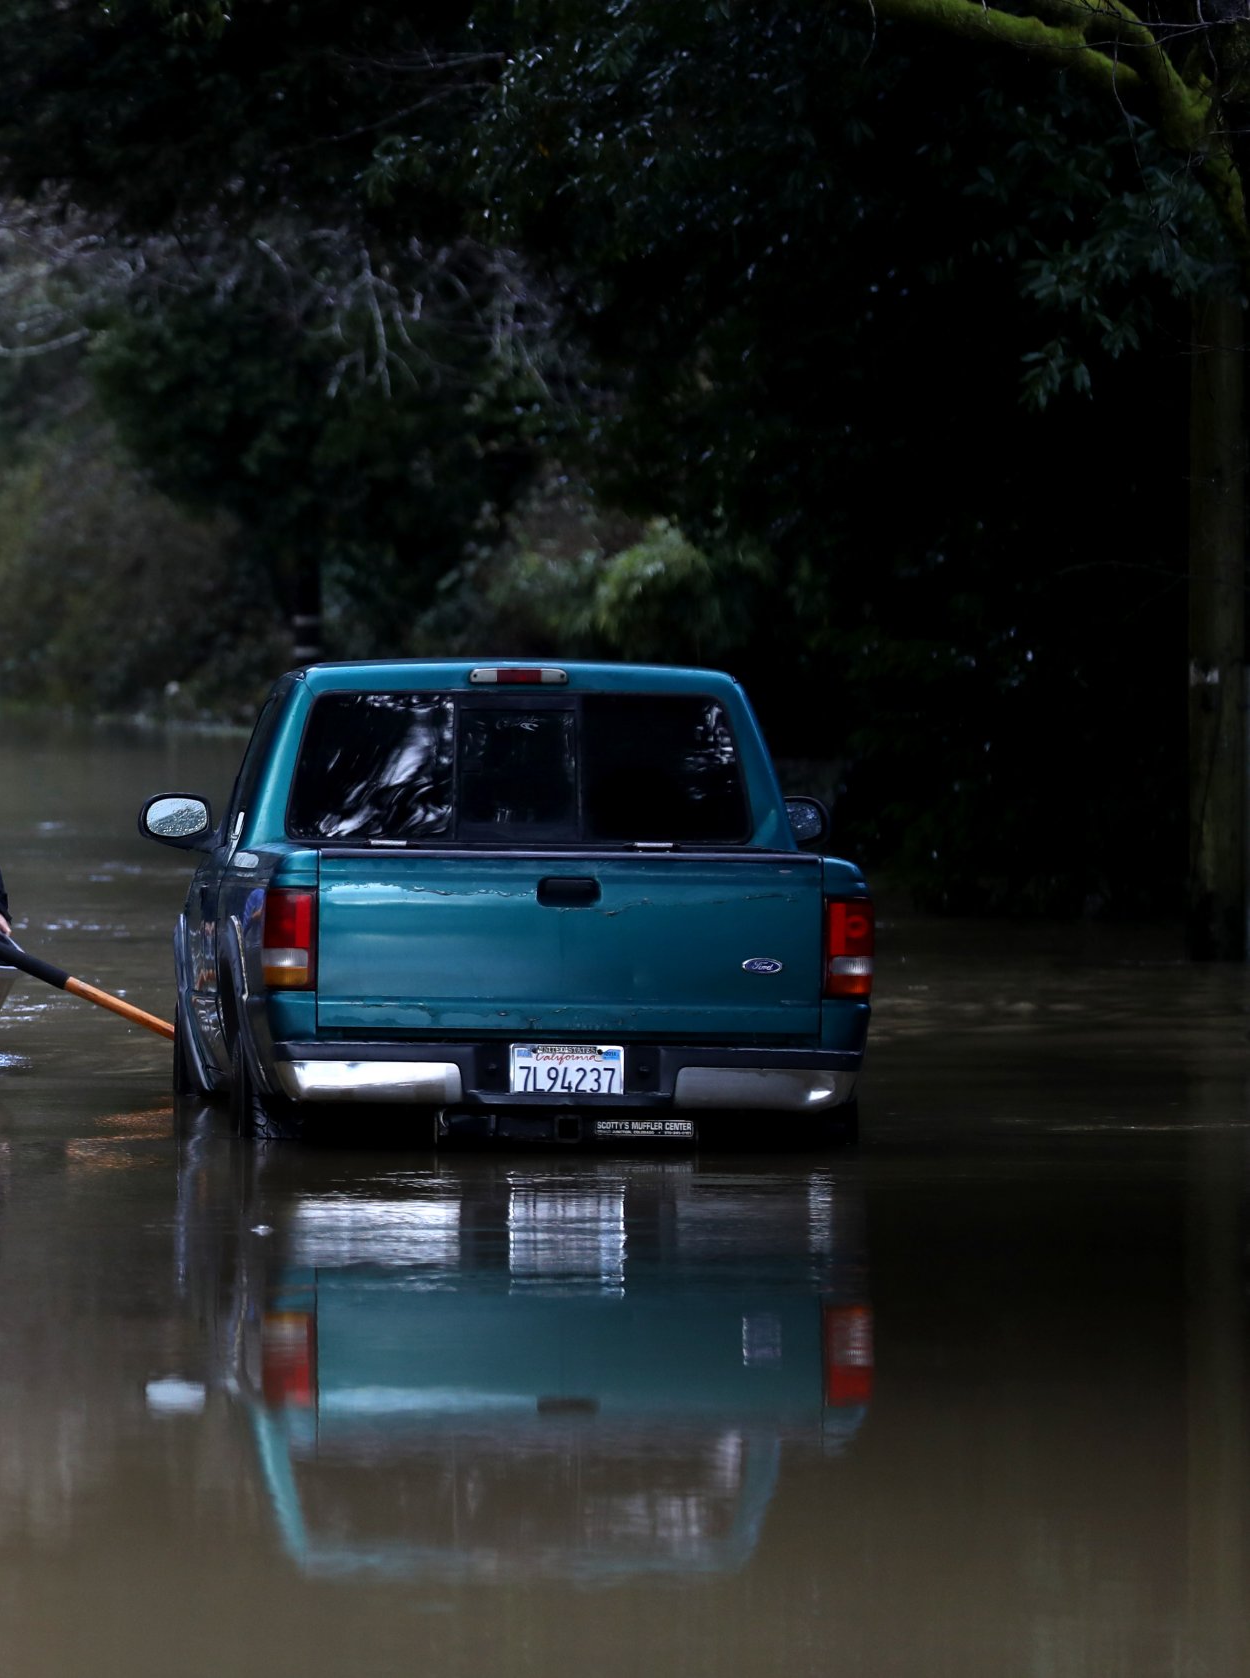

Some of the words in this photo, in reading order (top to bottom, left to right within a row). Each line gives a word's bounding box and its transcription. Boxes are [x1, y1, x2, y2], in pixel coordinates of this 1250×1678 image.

[752, 961, 774, 971] Ford
[537, 1046, 567, 1054] UNITED
[567, 1046, 597, 1055] STATES
[535, 1052, 603, 1066] California
[518, 1065, 616, 1093] 7L94237
[596, 1121, 630, 1130] SCOTTY'S
[631, 1121, 663, 1131] MUFFLER
[664, 1122, 692, 1131] CENTER
